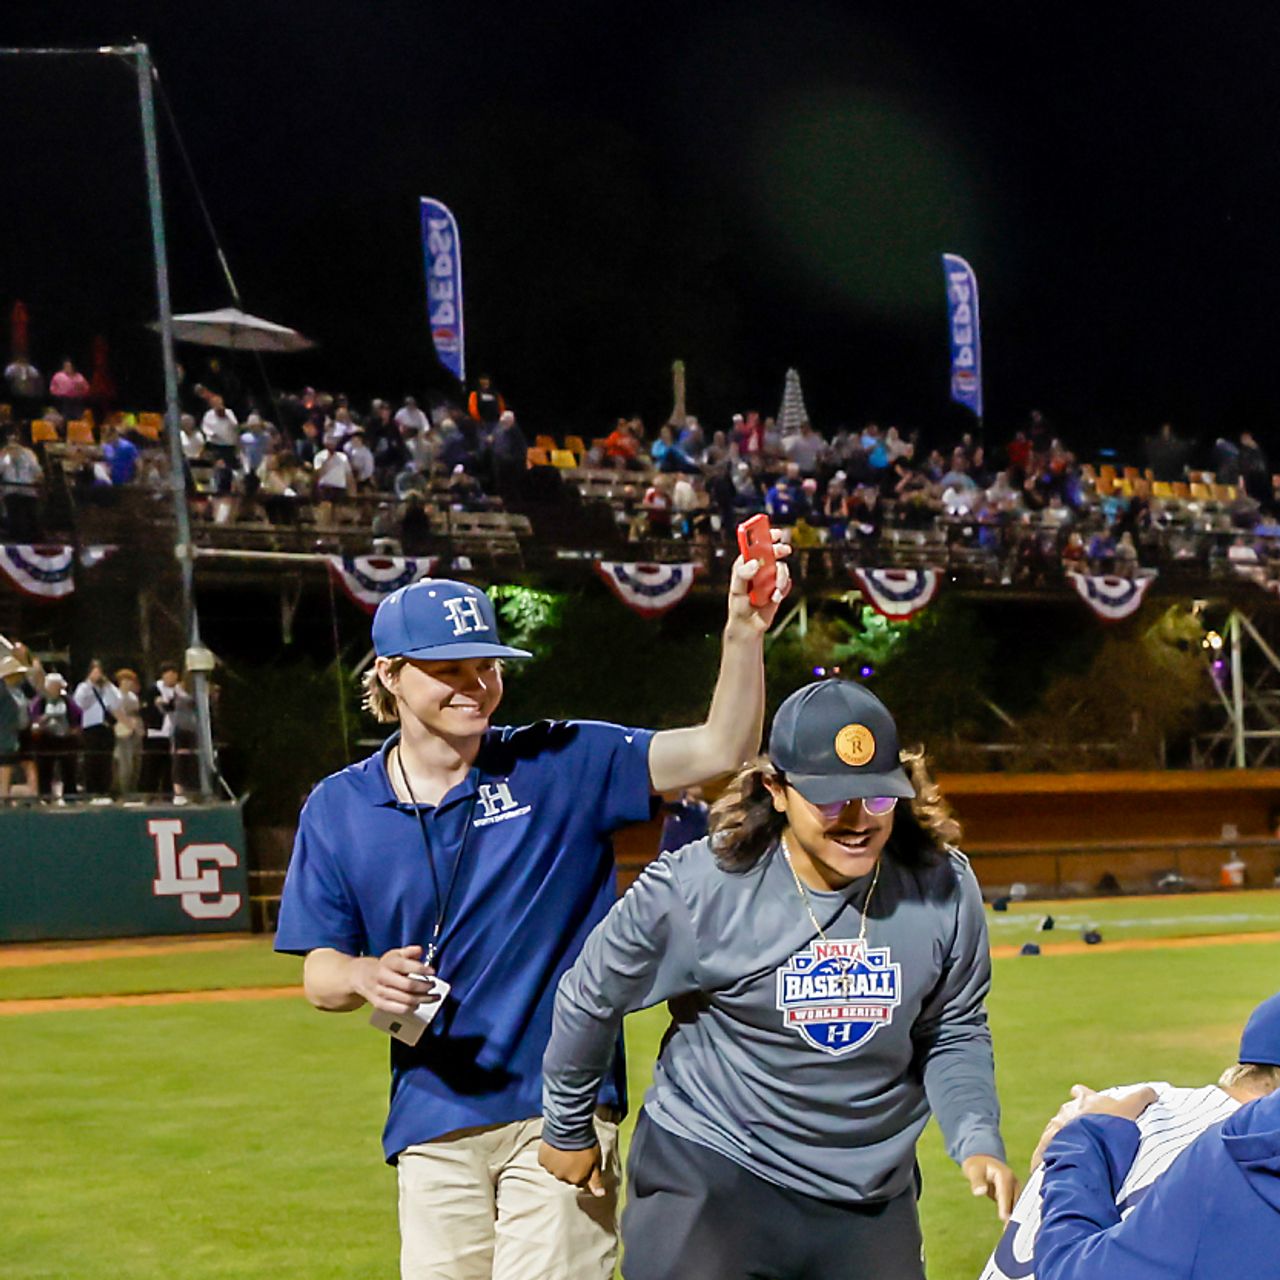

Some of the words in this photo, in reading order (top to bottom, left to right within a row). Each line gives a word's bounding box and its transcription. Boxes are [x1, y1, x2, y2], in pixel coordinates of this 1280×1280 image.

[443, 596, 489, 636] H
[477, 783, 519, 817] H
[815, 944, 864, 961] NAIA
[793, 1009, 840, 1020] WORLD
[842, 1007, 883, 1018] SERIES
[827, 1023, 850, 1043] H
